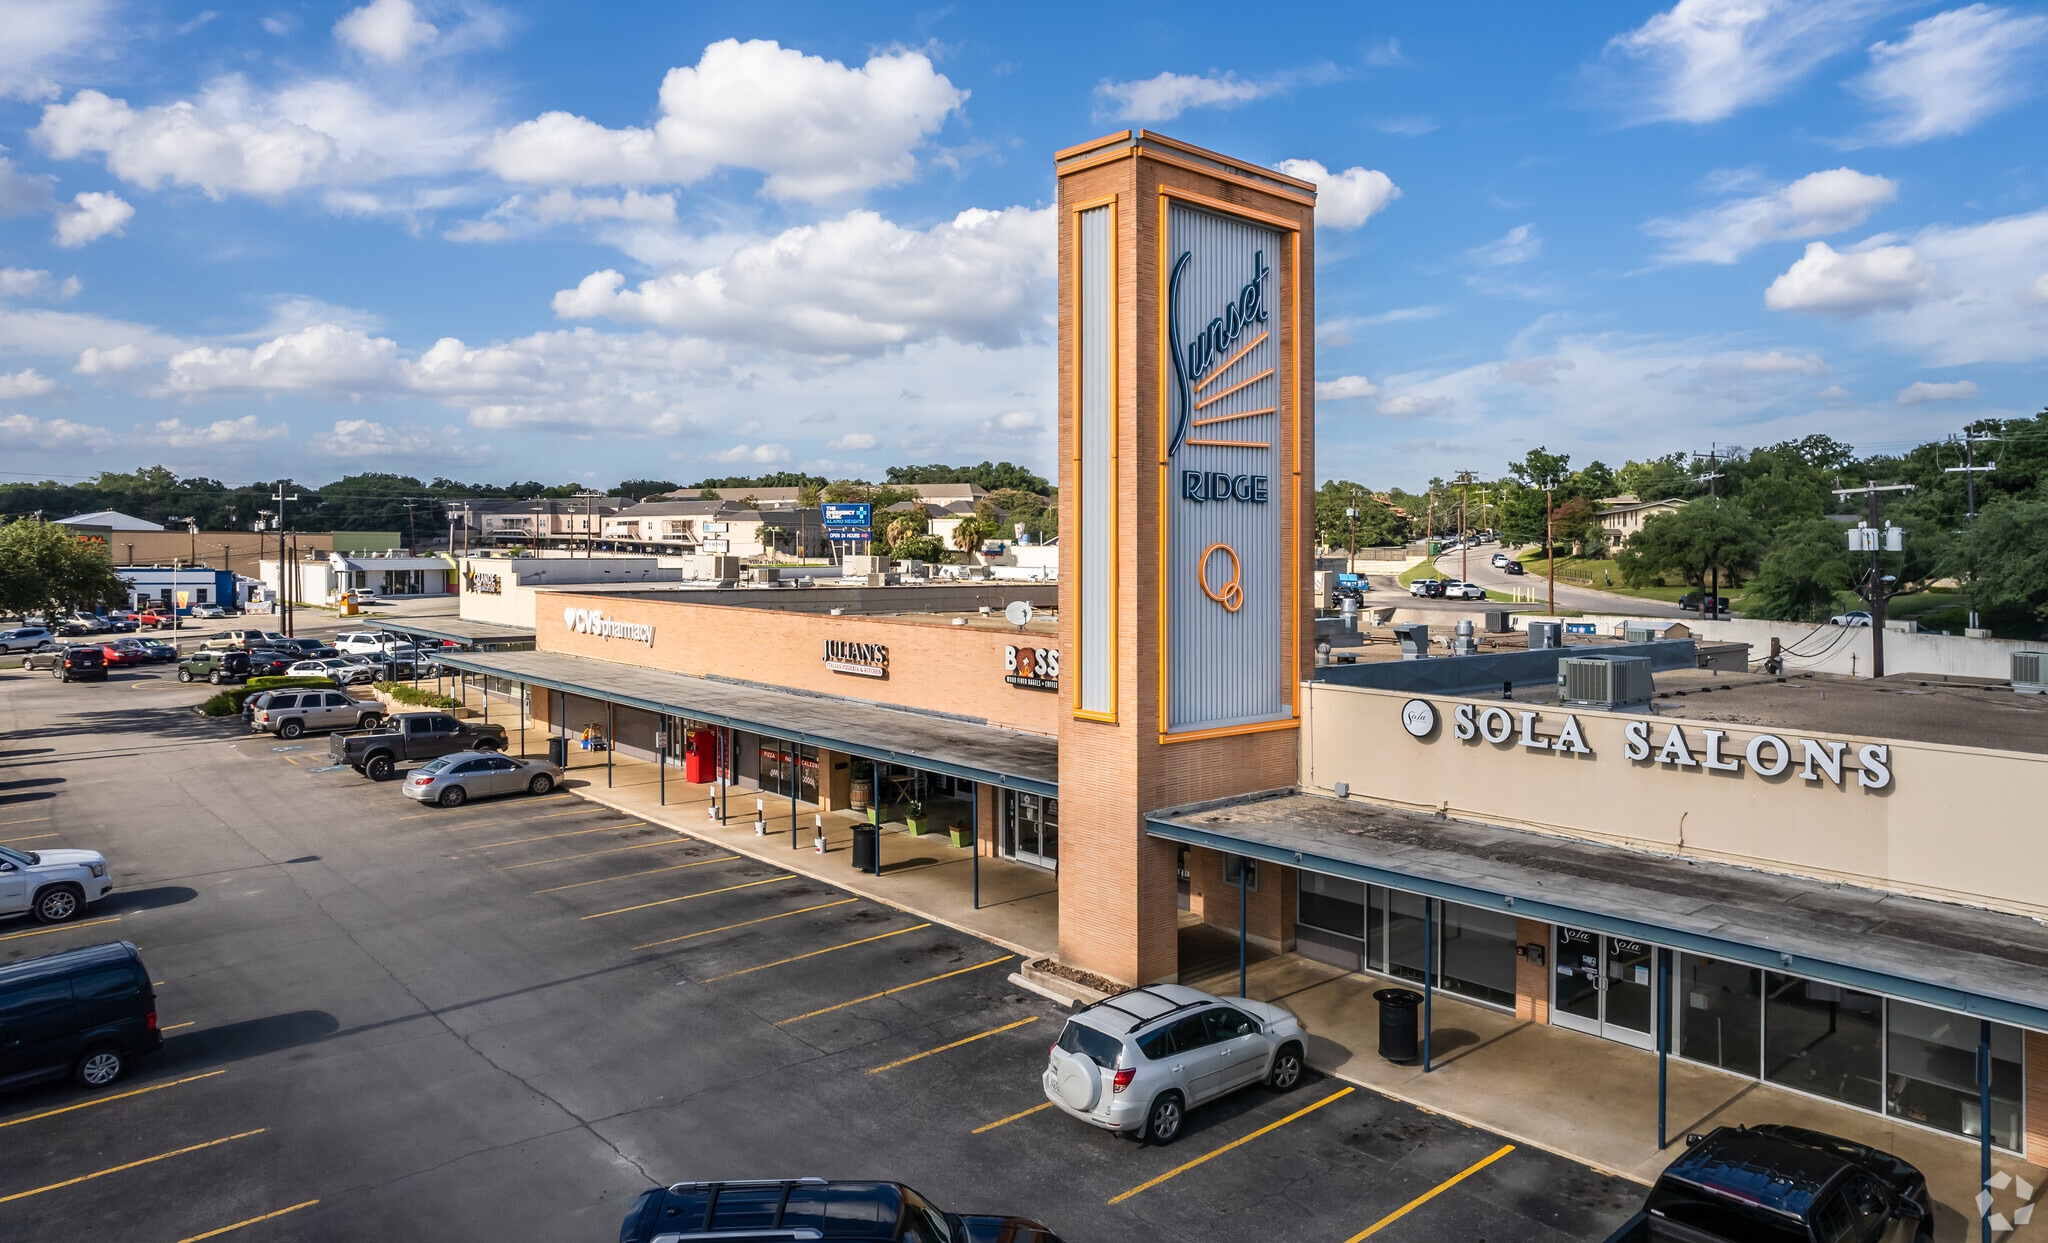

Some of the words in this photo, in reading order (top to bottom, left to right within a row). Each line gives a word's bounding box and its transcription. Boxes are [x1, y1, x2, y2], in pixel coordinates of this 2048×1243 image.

[1168, 250, 1270, 457] Sunset
[1182, 469, 1269, 503] RIDGE
[820, 640, 884, 664] JULIAN'S
[1406, 709, 1430, 726] Sola
[1453, 704, 1592, 755] SOLA
[1623, 721, 1893, 791] SALONS
[1560, 926, 1592, 944] Sola
[1610, 937, 1642, 956] Sola
